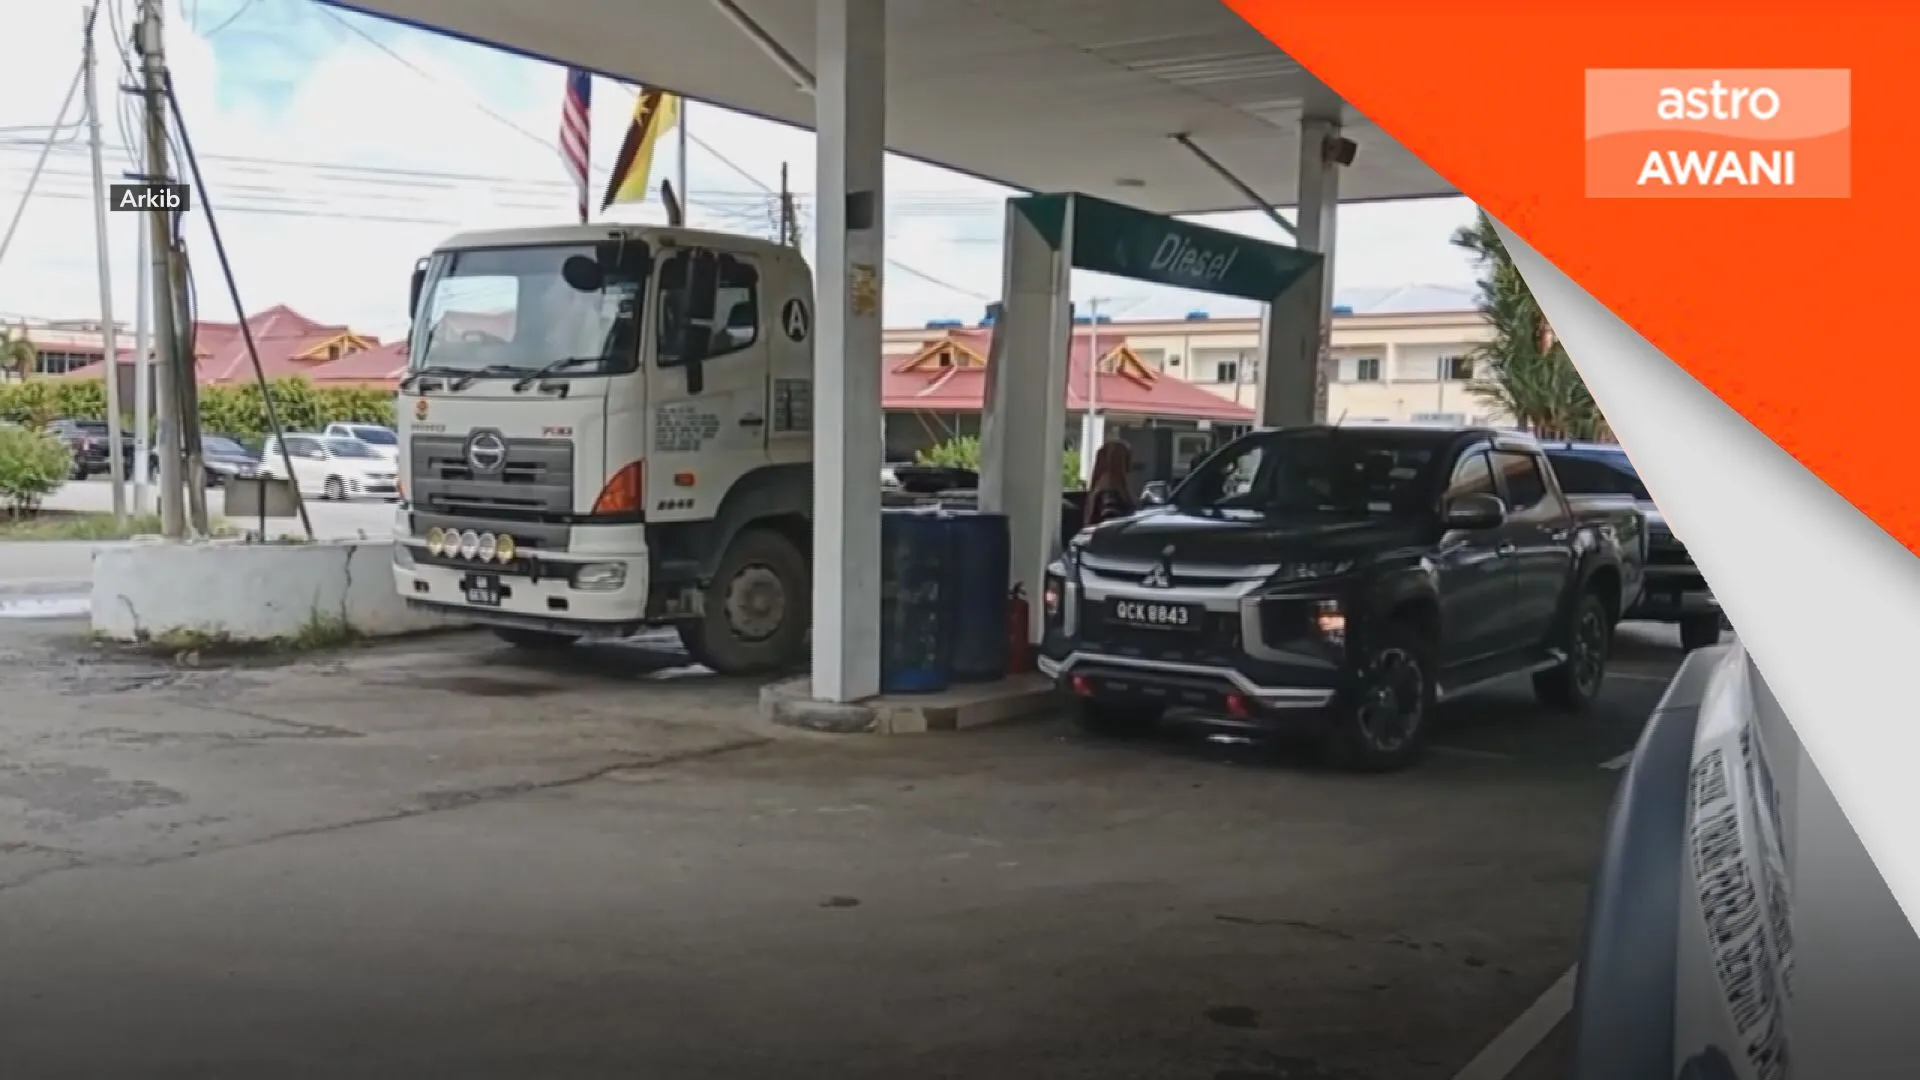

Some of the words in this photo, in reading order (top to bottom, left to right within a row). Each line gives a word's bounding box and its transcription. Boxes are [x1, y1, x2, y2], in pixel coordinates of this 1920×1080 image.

[1149, 232, 1240, 281] Diesel
[787, 299, 807, 337] A
[1117, 600, 1146, 621] QCK
[1147, 604, 1189, 625] 8843
